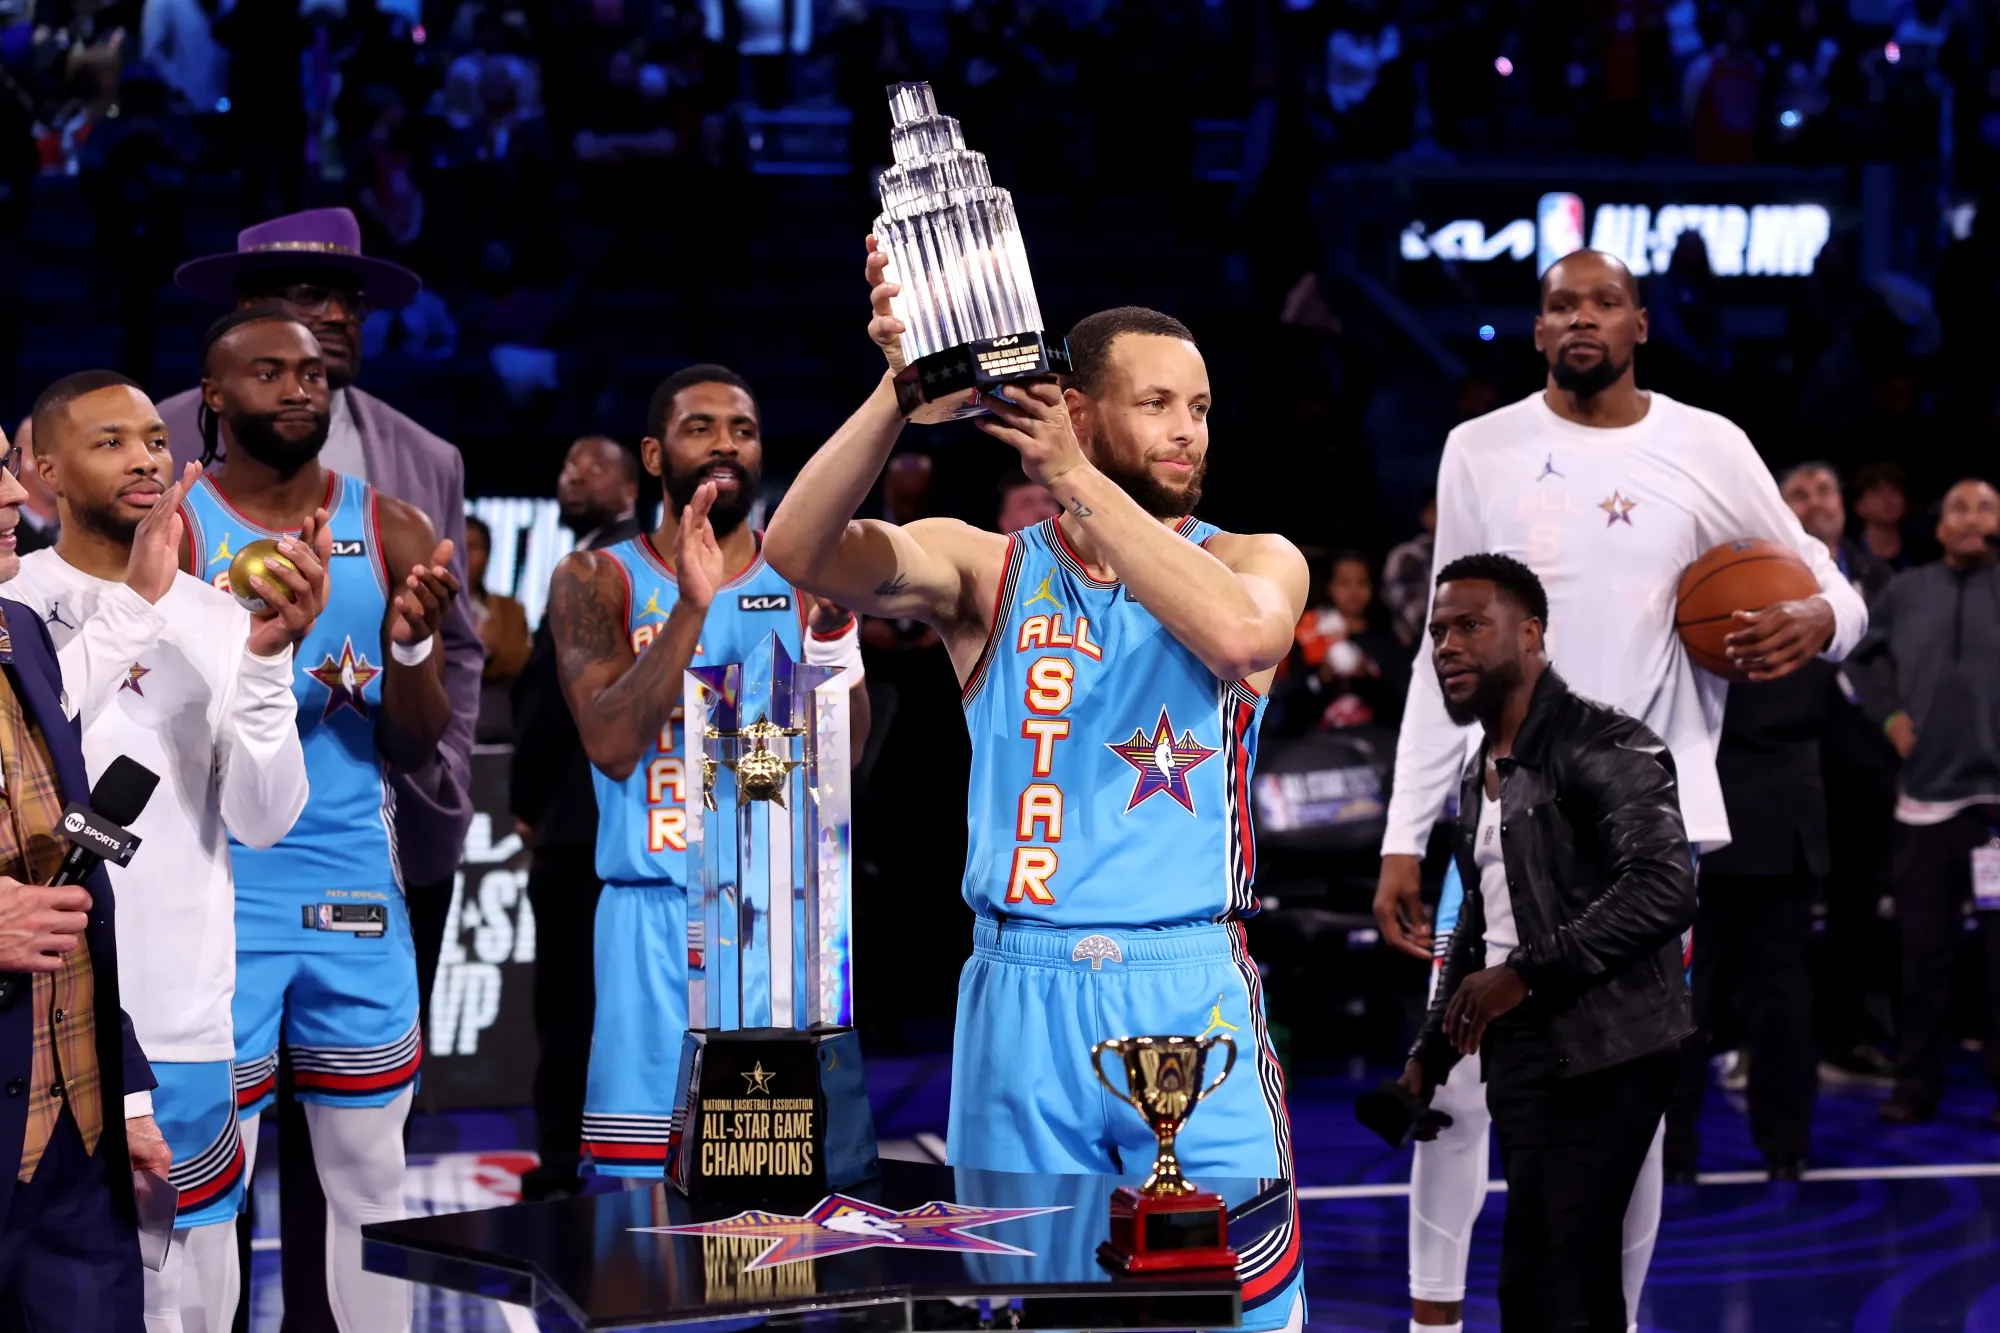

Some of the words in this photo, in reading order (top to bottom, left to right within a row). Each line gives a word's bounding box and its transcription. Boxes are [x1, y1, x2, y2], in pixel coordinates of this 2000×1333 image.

[992, 335, 1019, 347] KIA
[742, 596, 787, 610] KIA
[1016, 613, 1103, 662] ALL
[647, 705, 687, 852] TAR
[1004, 656, 1075, 905] STAR
[65, 814, 85, 832] TNT
[84, 825, 121, 850] SPORTS
[702, 1098, 733, 1111] NATIONAL
[733, 1098, 772, 1111] BASKETBALL
[772, 1098, 814, 1111] ASSOCIATION
[702, 1113, 770, 1139] ALL-STAR
[774, 1112, 813, 1139] GAME
[701, 1141, 814, 1176] CHAMPIONS
